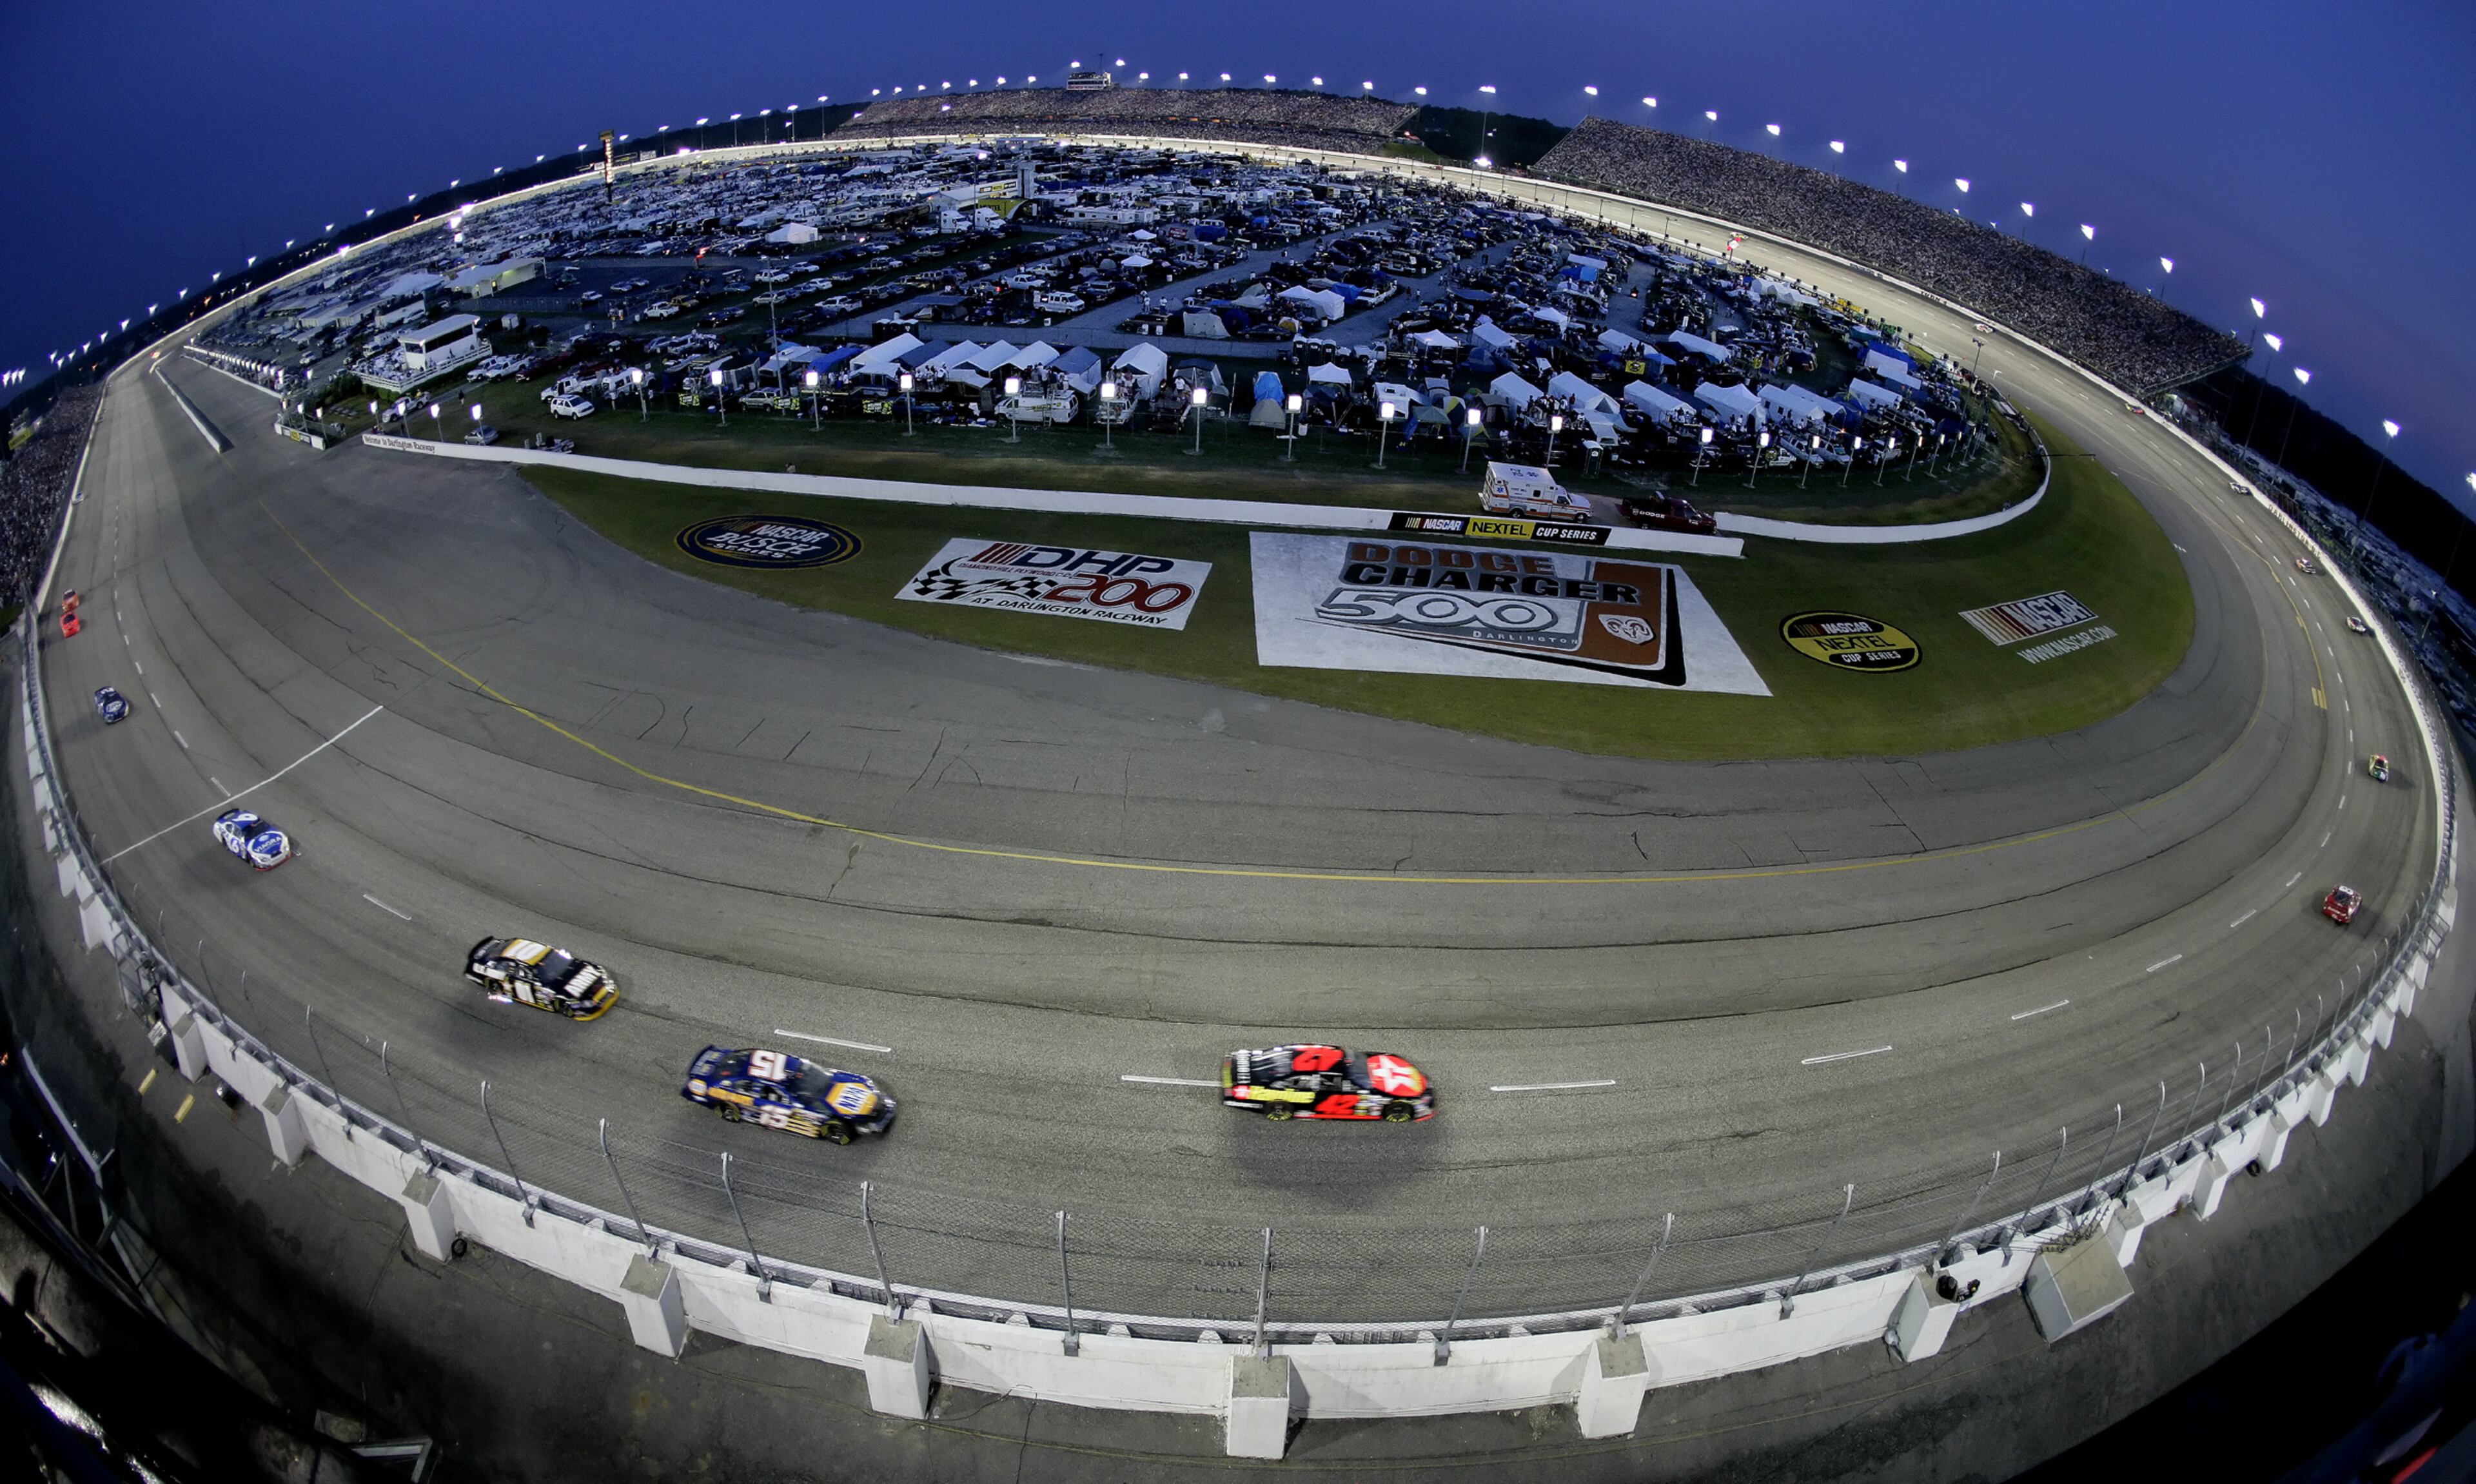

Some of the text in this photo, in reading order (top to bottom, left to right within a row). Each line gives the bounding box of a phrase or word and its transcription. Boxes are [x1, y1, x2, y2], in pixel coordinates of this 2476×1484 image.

[388, 438, 413, 451] Darlington
[413, 442, 435, 453] Raceway
[1639, 510, 1665, 519] DODGE
[750, 523, 829, 543] NASCAR
[1422, 518, 1597, 540] NASCAR NEXTEL CUP SERIES
[707, 532, 821, 555] BUSCH
[712, 543, 785, 558] SERIES
[957, 563, 996, 572] DIAMOND
[1008, 547, 1175, 576] DHP
[1351, 543, 1555, 575] DODGE
[1041, 574, 1195, 612] 200
[1343, 563, 1640, 603] CHARGER
[996, 600, 1097, 616] DARLINGTON
[1094, 610, 1169, 625] RACEWAY
[1314, 587, 1558, 631] 500
[2007, 594, 2094, 632] NASCAR
[1472, 630, 1579, 645] DARLINGTON
[1821, 621, 1872, 634] NASCAR
[1816, 635, 1896, 652] NEXTEL
[2016, 625, 2118, 665] WWW.NASCAR.COM
[1842, 650, 1901, 663] CUP SERIES
[231, 839, 239, 853] 6
[254, 836, 282, 852] VIAGRA
